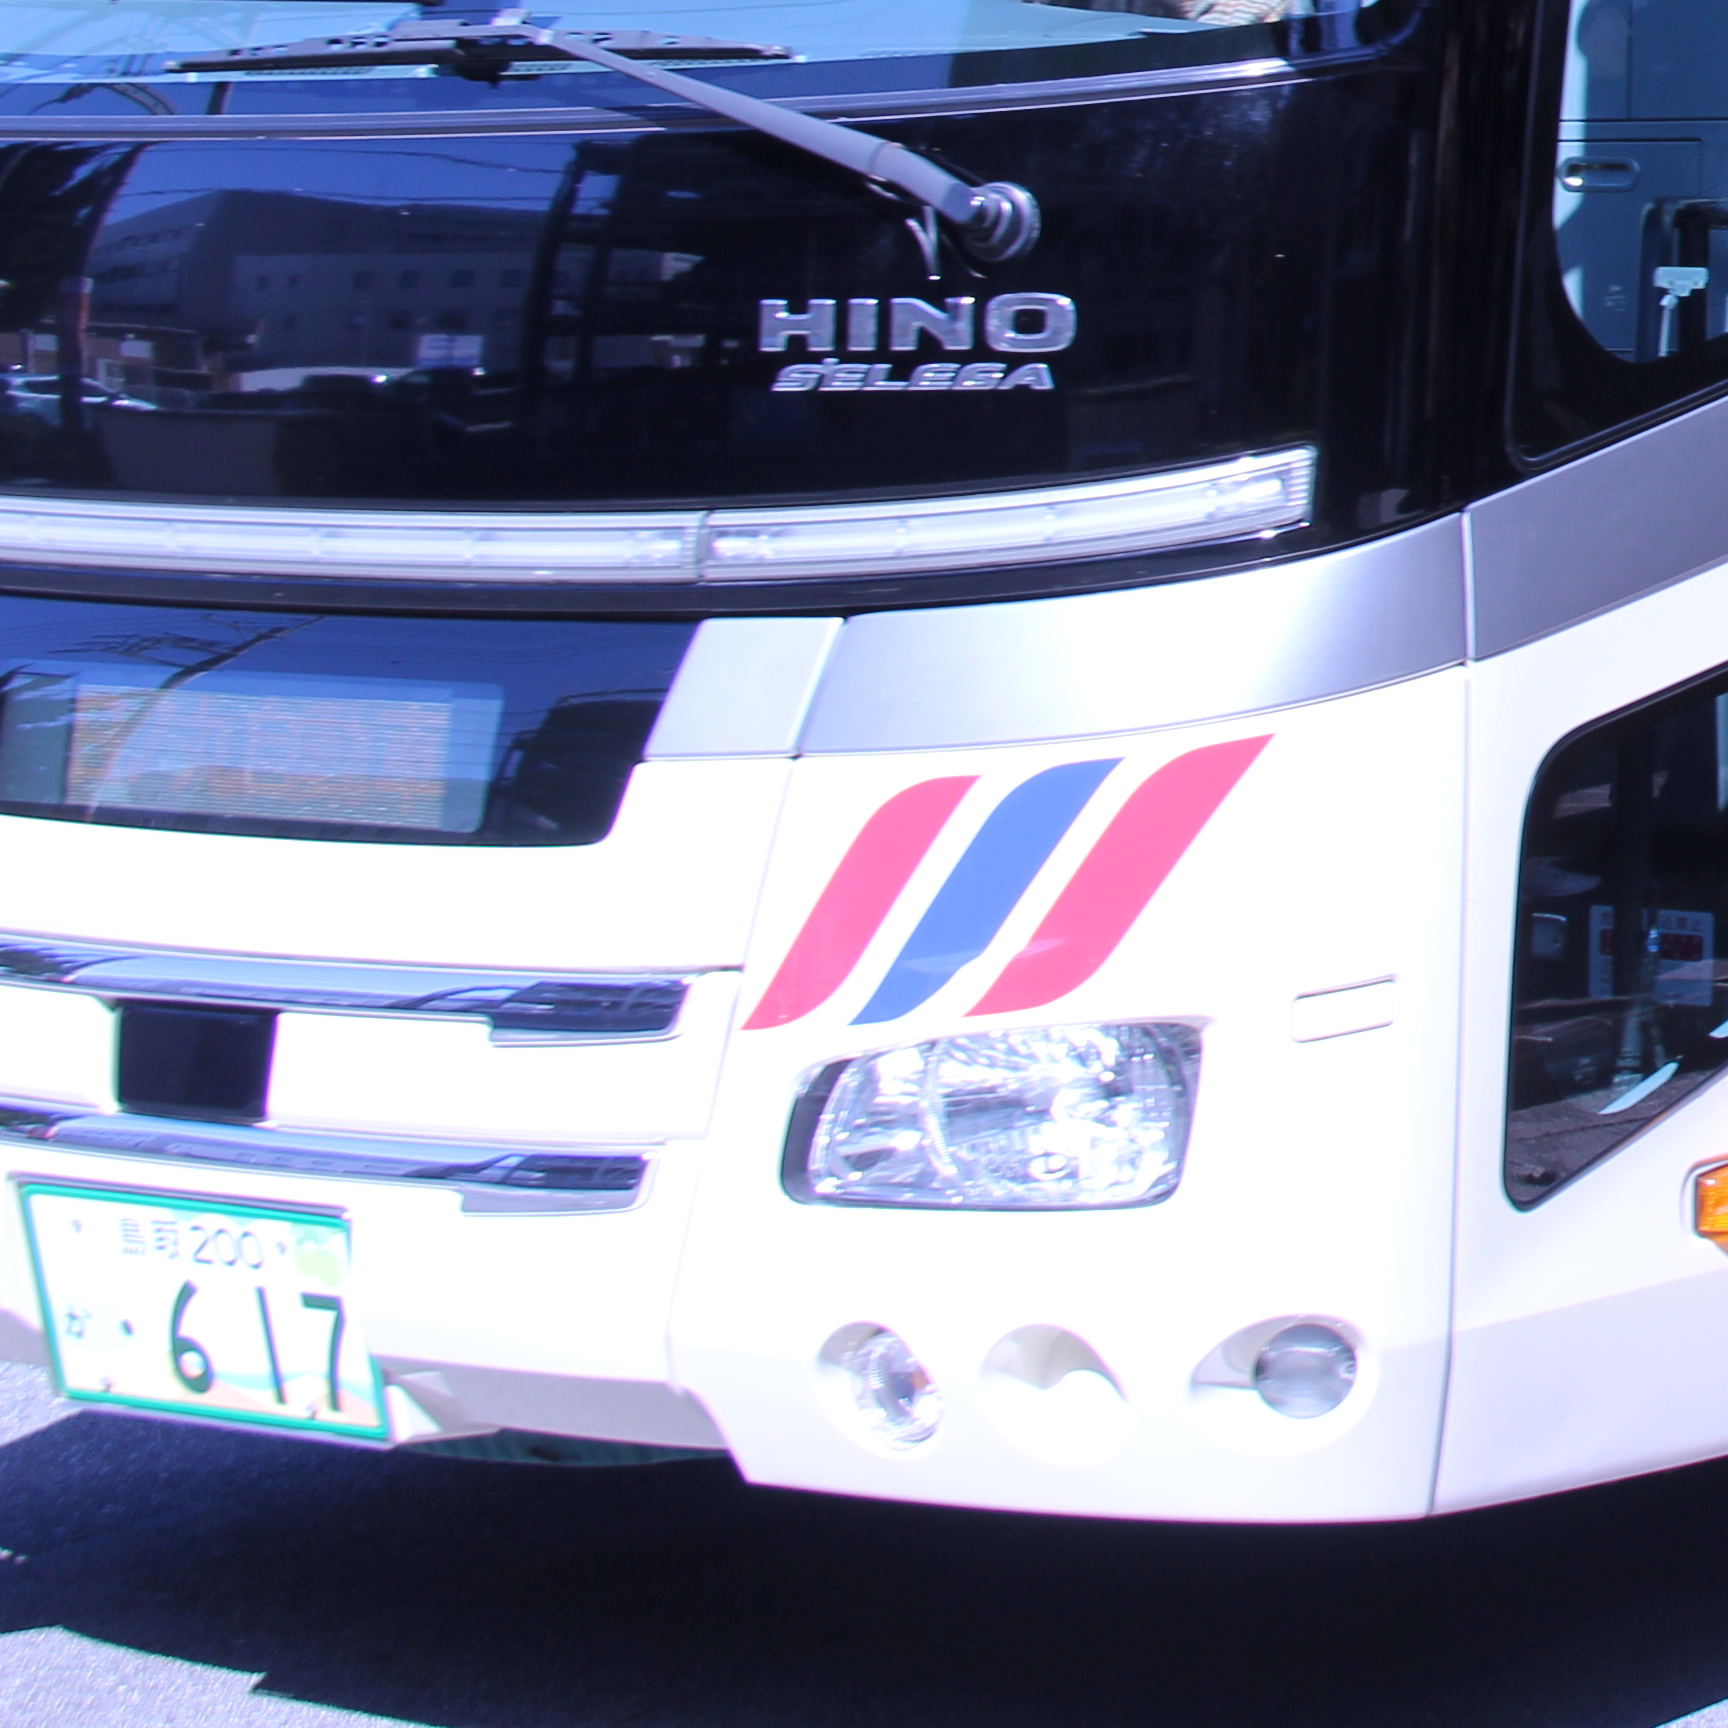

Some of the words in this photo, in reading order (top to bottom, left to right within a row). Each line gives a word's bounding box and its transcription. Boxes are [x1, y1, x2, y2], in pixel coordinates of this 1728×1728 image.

[758, 292, 1078, 352] HINO
[771, 358, 1055, 392] SELEGA
[189, 1224, 265, 1270] 200
